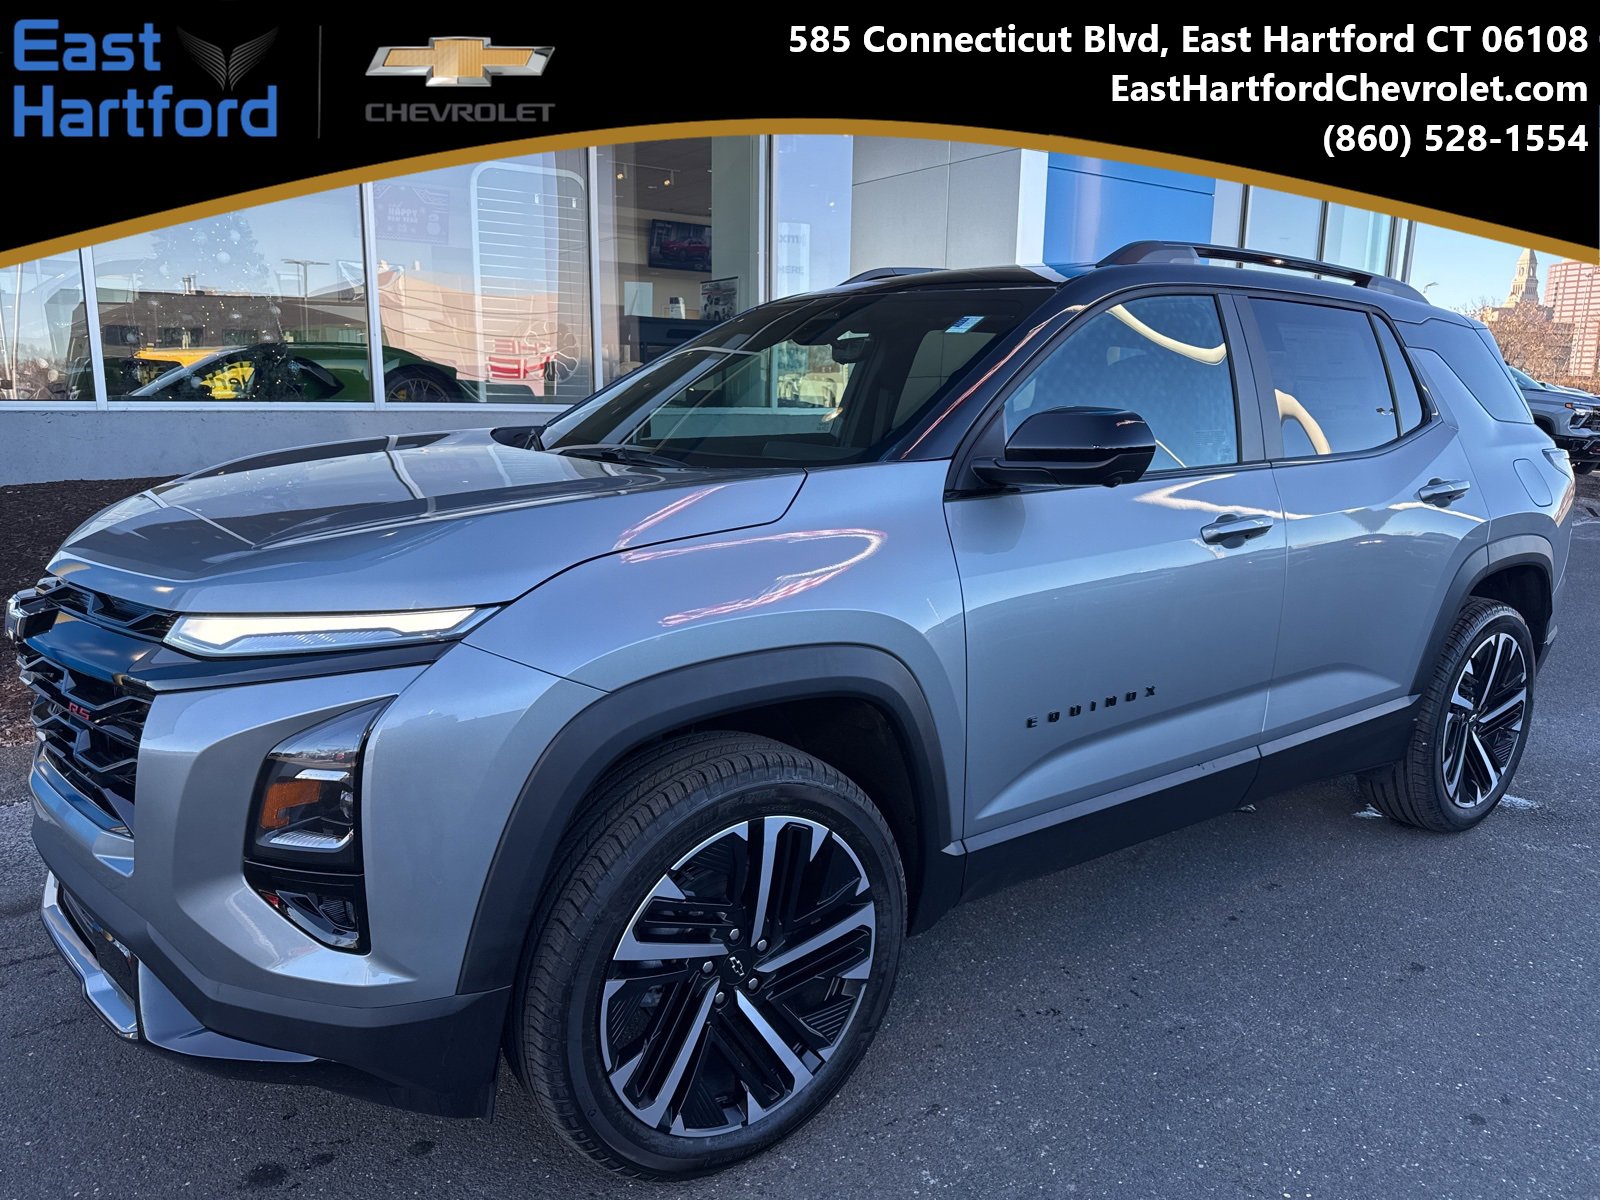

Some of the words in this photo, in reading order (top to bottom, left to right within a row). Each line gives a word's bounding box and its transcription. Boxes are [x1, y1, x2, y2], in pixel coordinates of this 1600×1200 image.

[388, 206, 418, 217] HAPPY
[68, 702, 91, 721] RS
[1026, 686, 1156, 728] EQUINOX
